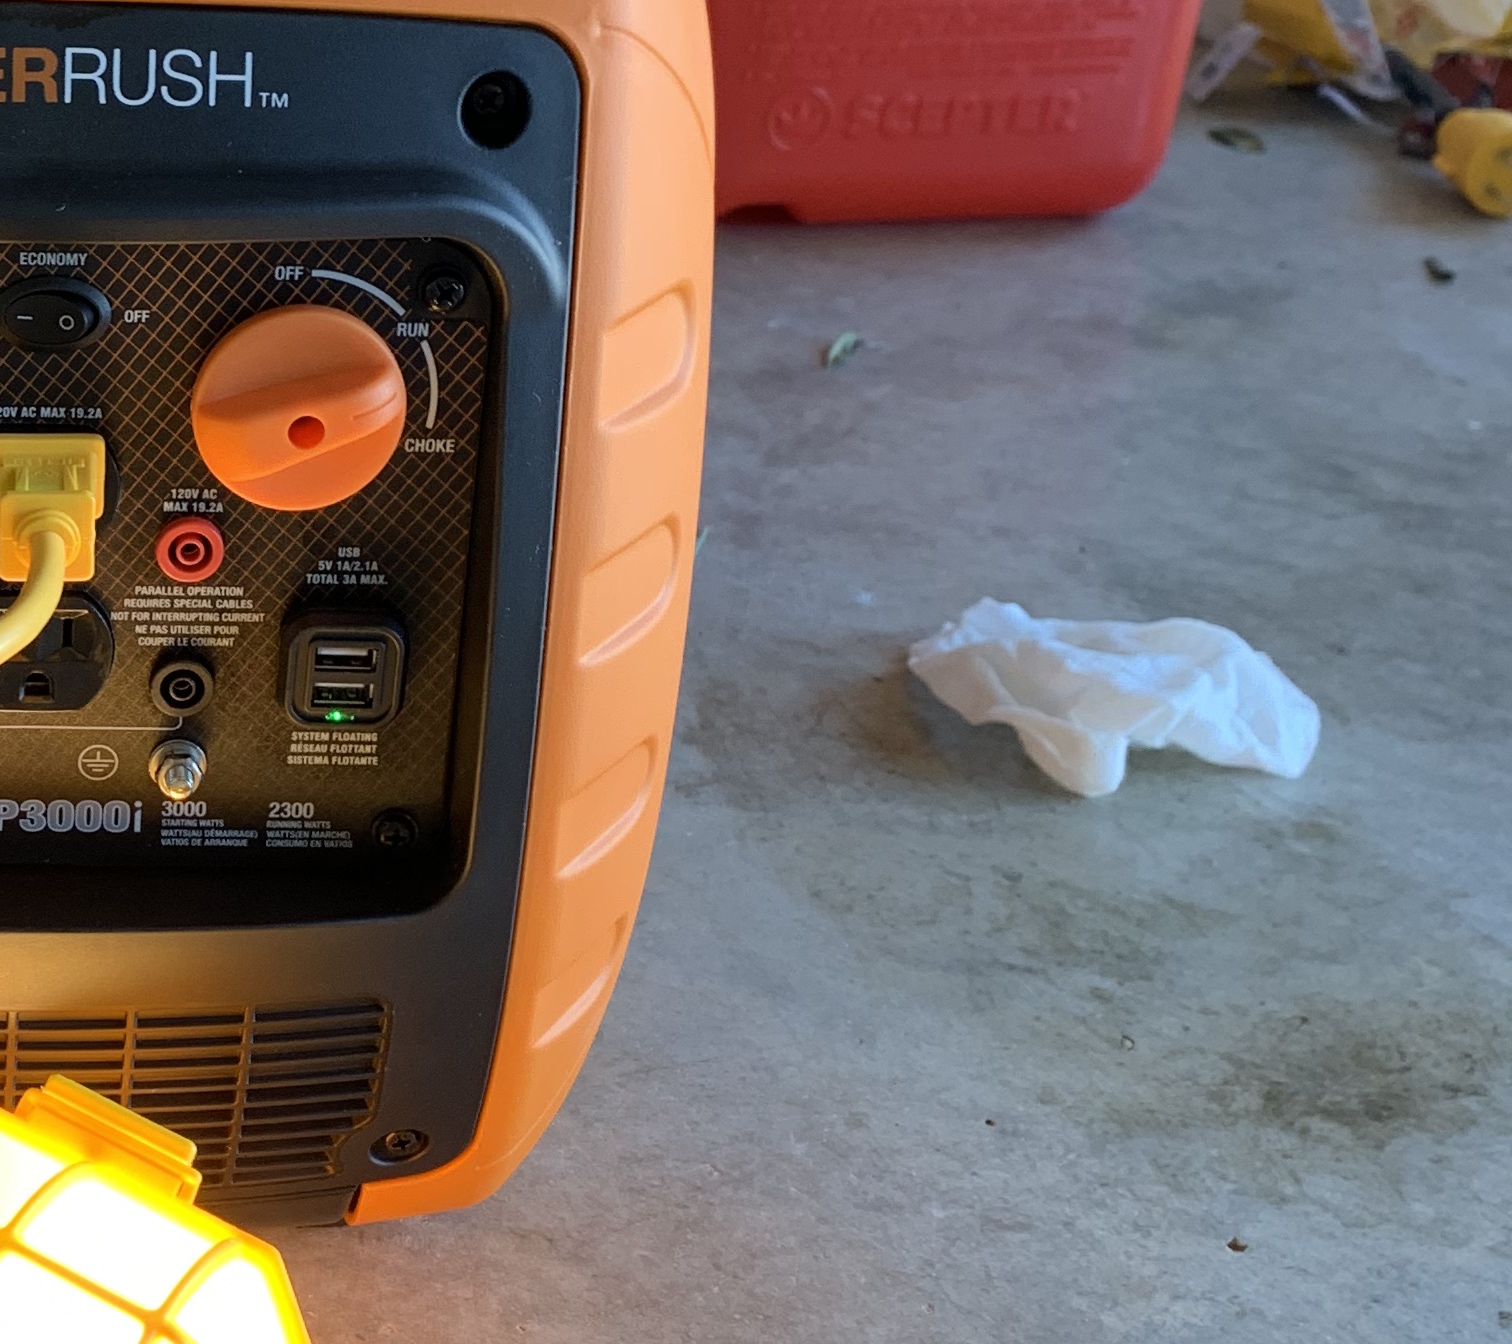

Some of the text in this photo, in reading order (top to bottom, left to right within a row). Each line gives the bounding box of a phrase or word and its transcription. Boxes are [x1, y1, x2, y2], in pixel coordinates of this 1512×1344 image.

[19, 252, 88, 267] ECONOMY
[274, 265, 304, 282] OFF
[124, 309, 150, 324] OFF
[396, 321, 430, 339] RUN
[20, 407, 37, 420] AC
[40, 407, 66, 420] MAX
[69, 407, 103, 420] 19.2A
[404, 438, 455, 455] CHOKE
[170, 488, 218, 500] 120V AC
[163, 501, 224, 513] MAX 19.2A
[337, 546, 361, 558] USB
[317, 560, 379, 572] 5V 1A/2.1A
[305, 573, 388, 585] TOTAL 3A MAX.
[134, 585, 245, 597] PARALLEL OPERATION
[123, 598, 254, 609] REQUIRES SPECIAL CABLES
[110, 611, 266, 623] NOT FOR INTERRUPTING CURRENT
[134, 624, 240, 635] NE PAS UTILISER POUR
[138, 636, 236, 647] COUPER LE COURANT
[291, 731, 378, 742] SYSTEM FLOATING
[329, 743, 378, 754] FLOTTANT
[287, 755, 379, 766] SISTEMA FLOTANTE
[161, 800, 207, 818] 3000
[268, 801, 315, 819] 2300
[161, 818, 225, 828] STARTING WATTS
[304, 820, 331, 829] WATTS
